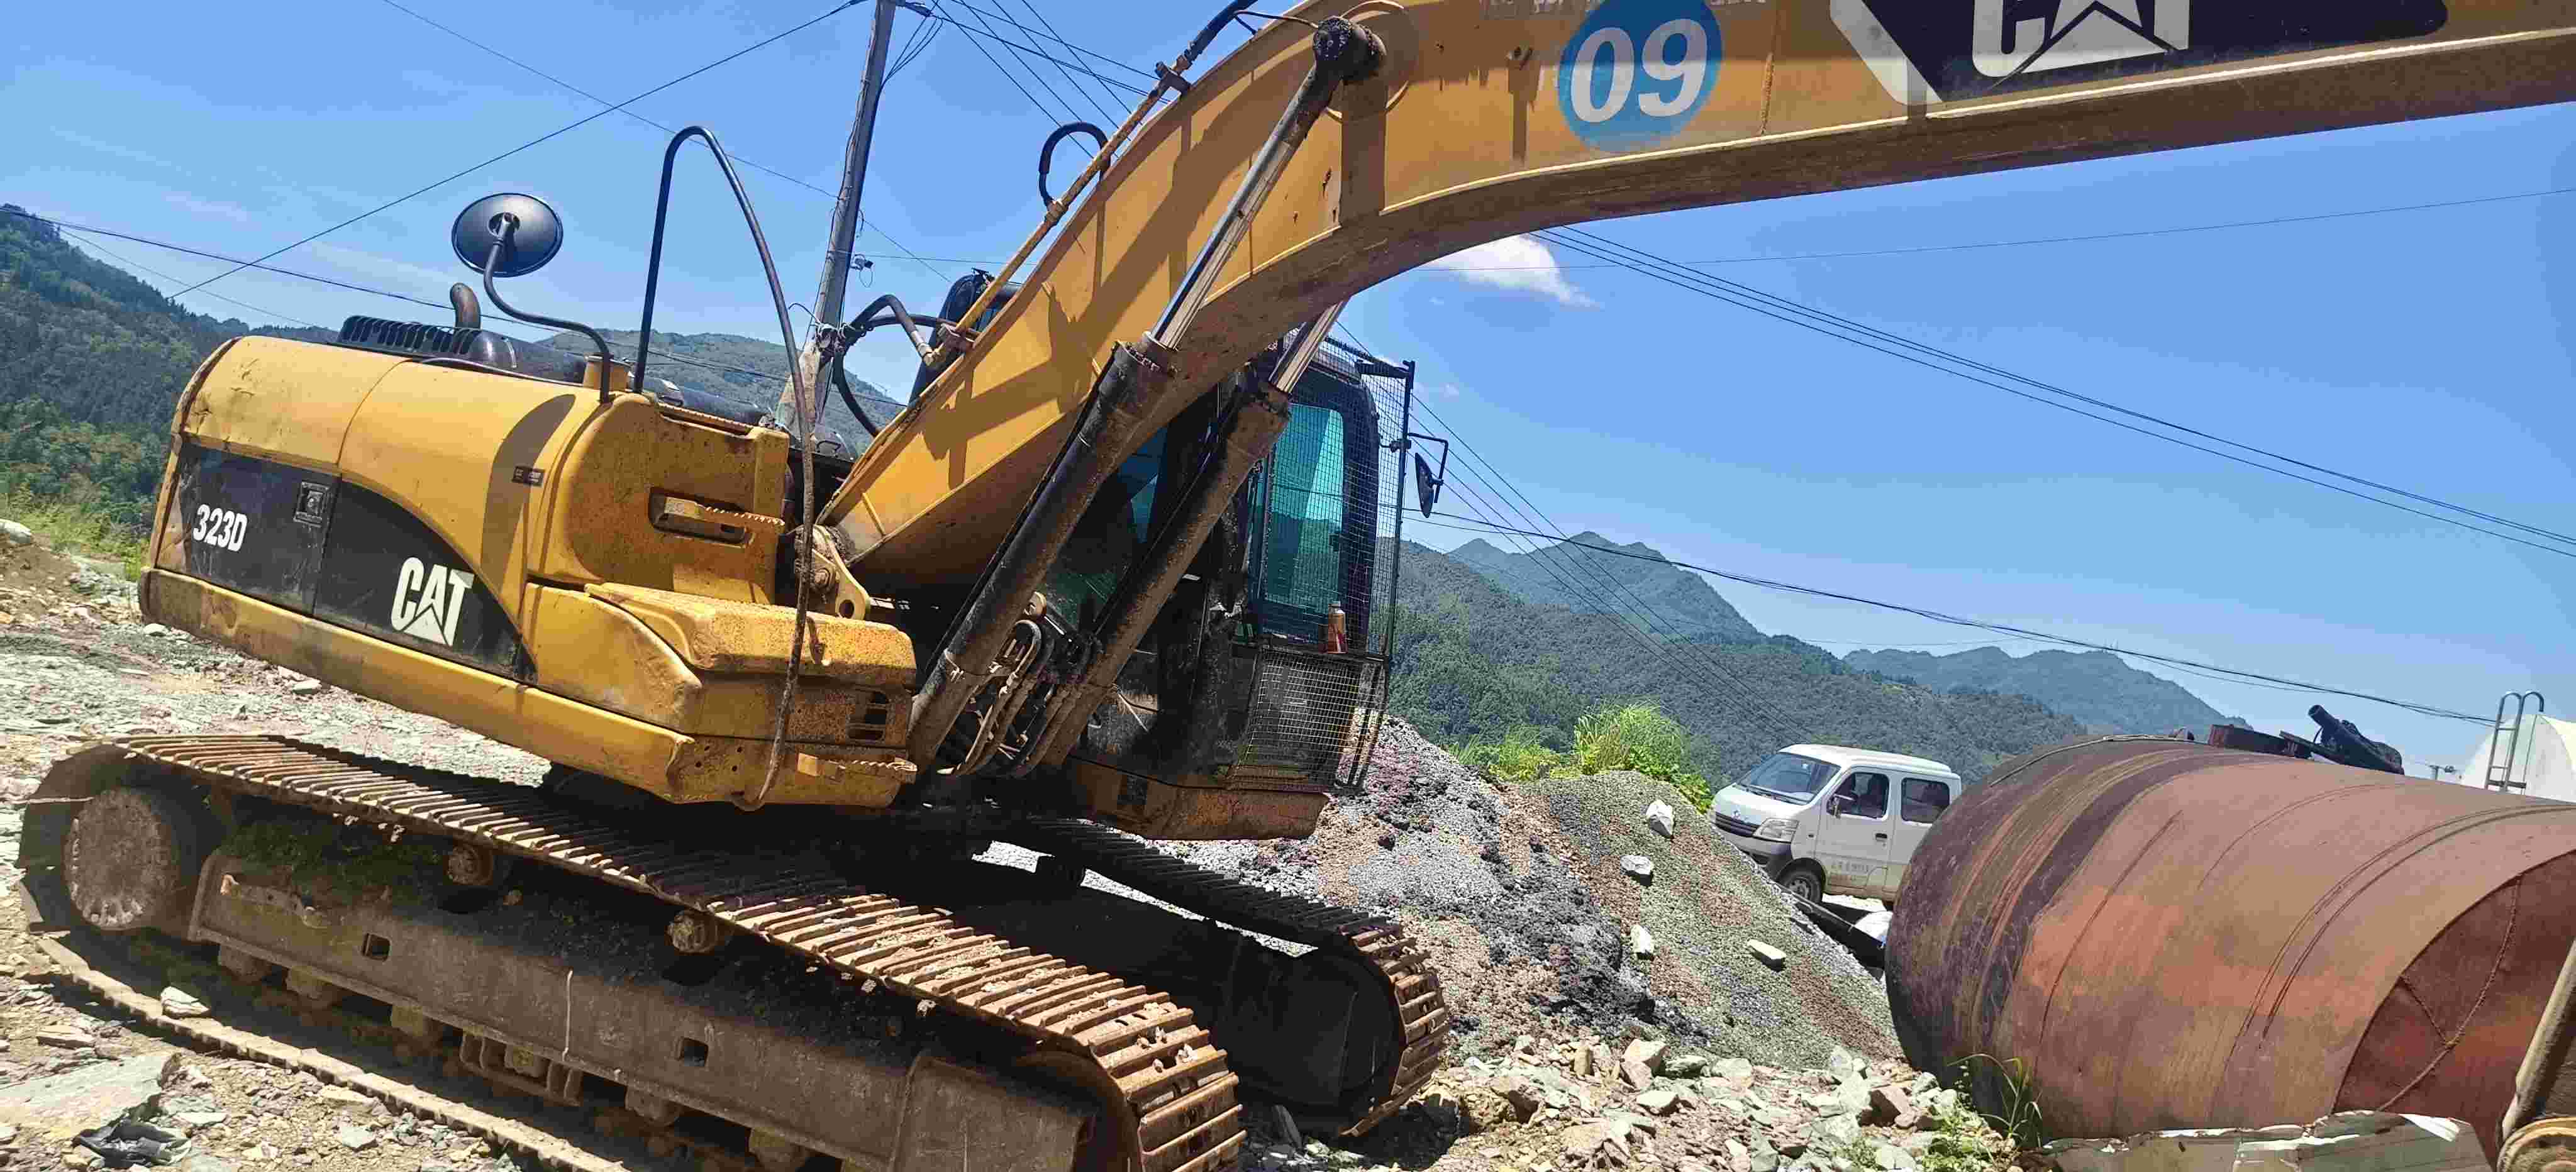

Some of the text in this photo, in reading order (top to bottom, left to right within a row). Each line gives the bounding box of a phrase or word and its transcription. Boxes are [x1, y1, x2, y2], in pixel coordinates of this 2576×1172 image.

[1571, 19, 1707, 123] 09
[192, 504, 248, 552] 323D
[391, 557, 474, 646] CAT
